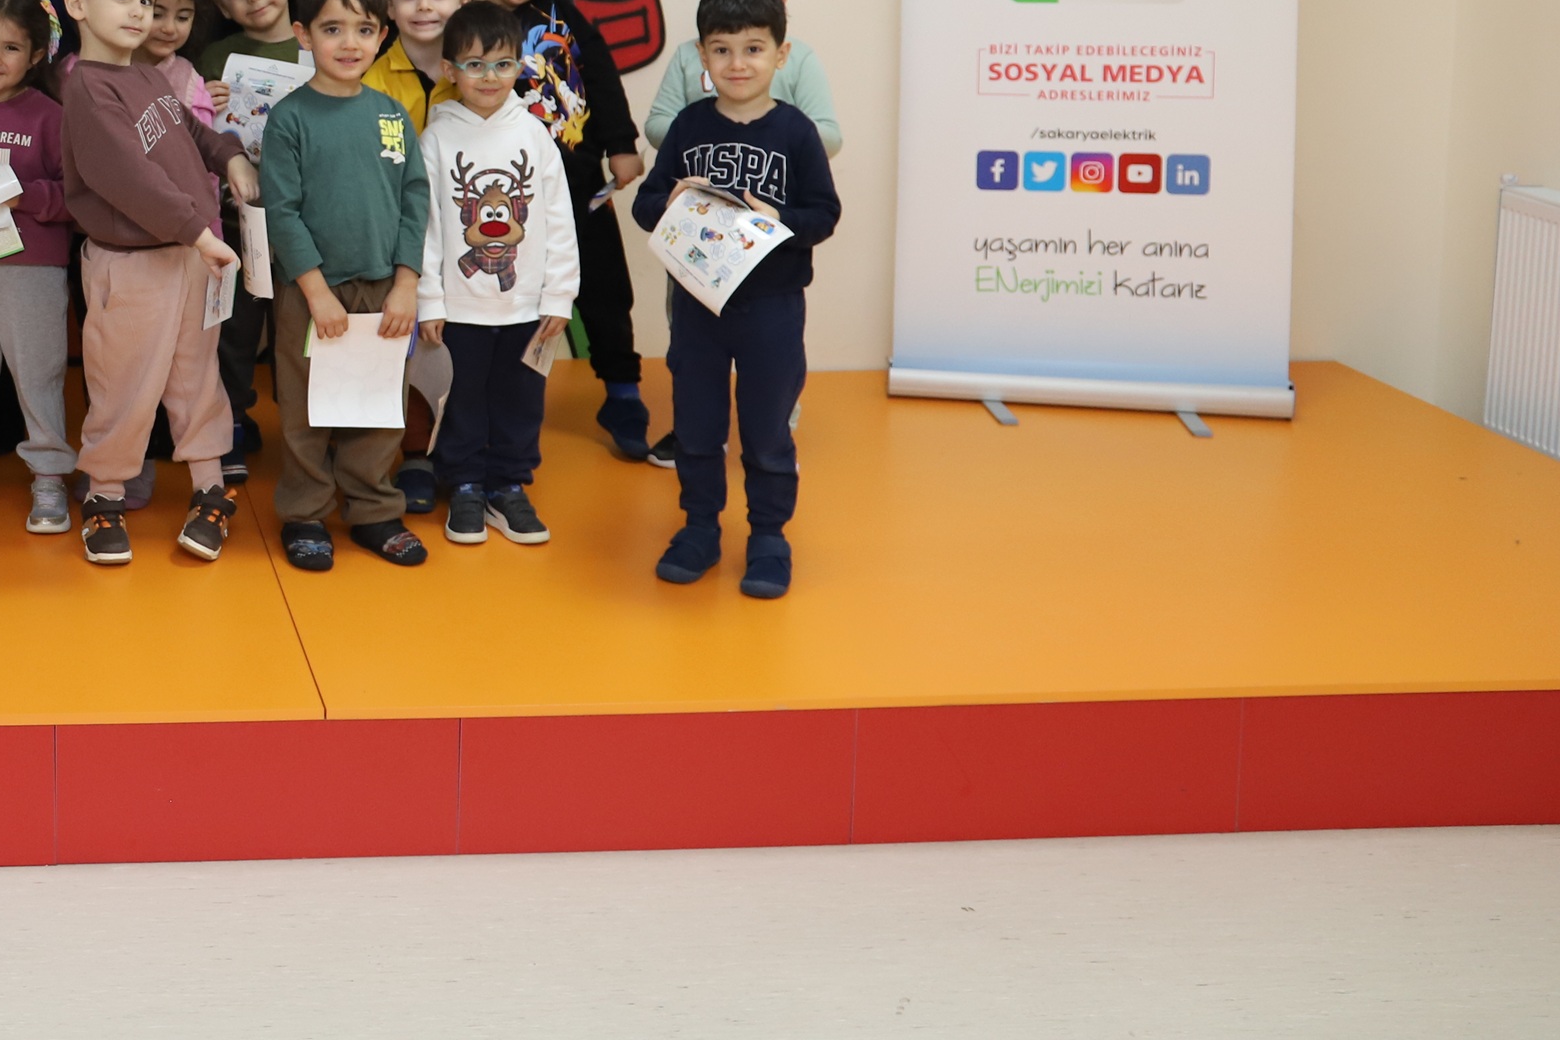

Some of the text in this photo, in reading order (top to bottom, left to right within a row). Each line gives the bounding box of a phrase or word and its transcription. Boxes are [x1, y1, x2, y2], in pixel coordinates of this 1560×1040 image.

[989, 43, 1018, 55] BİZİ
[1025, 43, 1070, 56] TAKİP
[988, 62, 1205, 84] SOSYAL MEDYA
[1037, 89, 1151, 102] ADRESLERİMİZ
[1031, 127, 1157, 142] /sakaryaelektrik
[683, 143, 787, 205] USPA
[973, 228, 1210, 261] yaşamın her anına
[975, 265, 1103, 303] ENerjimizi
